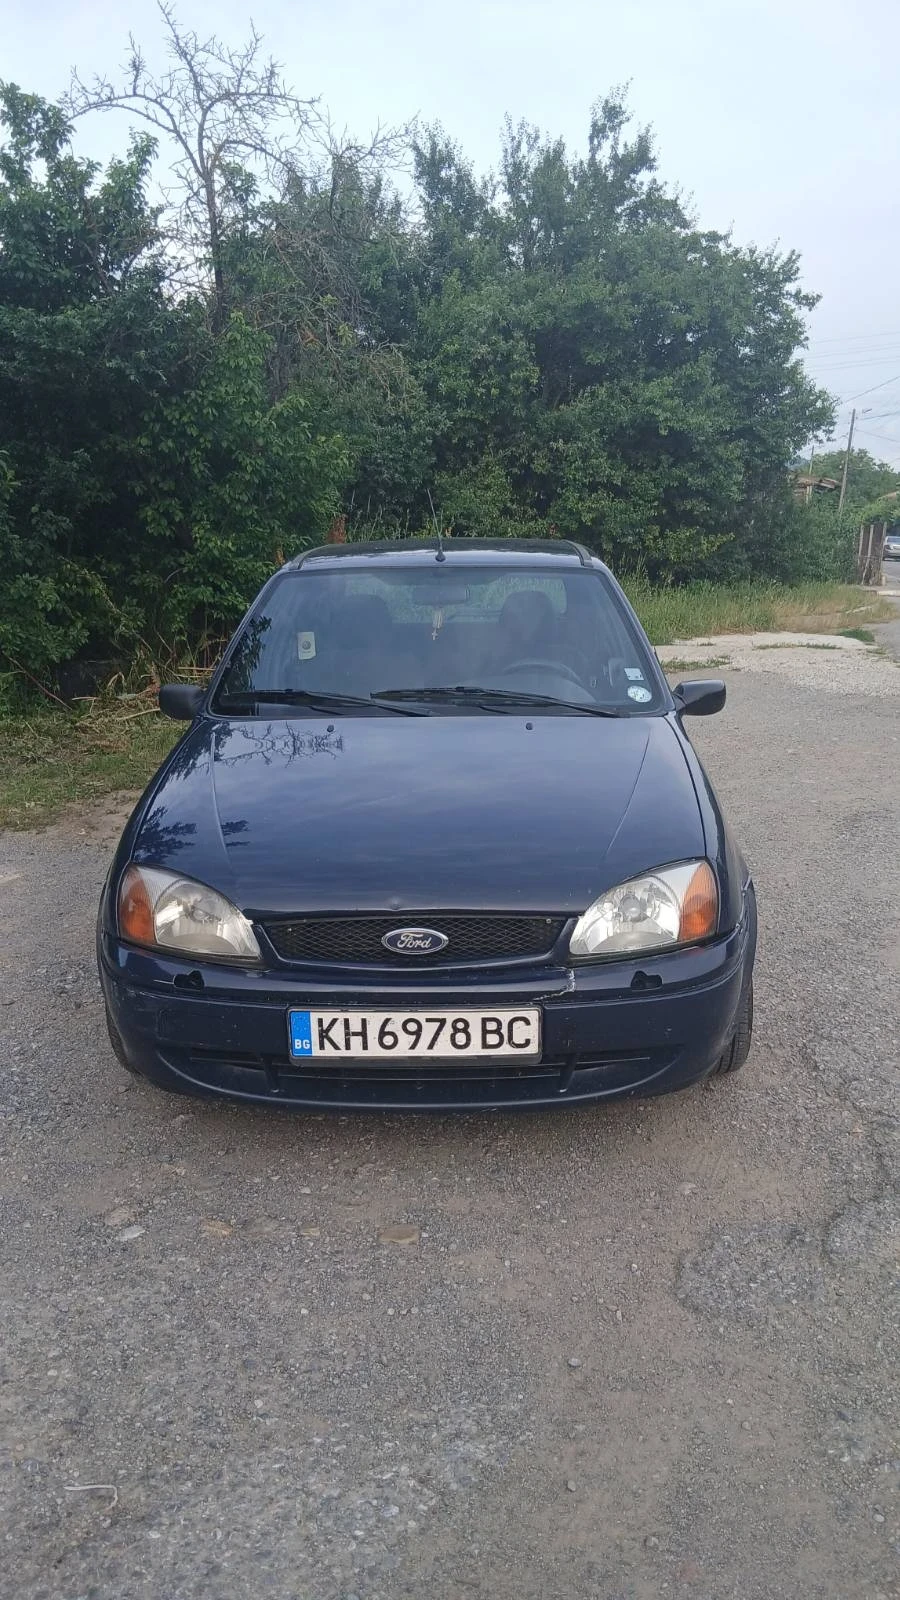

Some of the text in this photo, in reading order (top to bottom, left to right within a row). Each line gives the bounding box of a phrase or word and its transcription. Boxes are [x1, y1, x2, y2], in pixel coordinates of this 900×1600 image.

[397, 932, 432, 948] Ford
[317, 1016, 531, 1050] KH 6978 BC
[294, 1039, 311, 1049] BG
